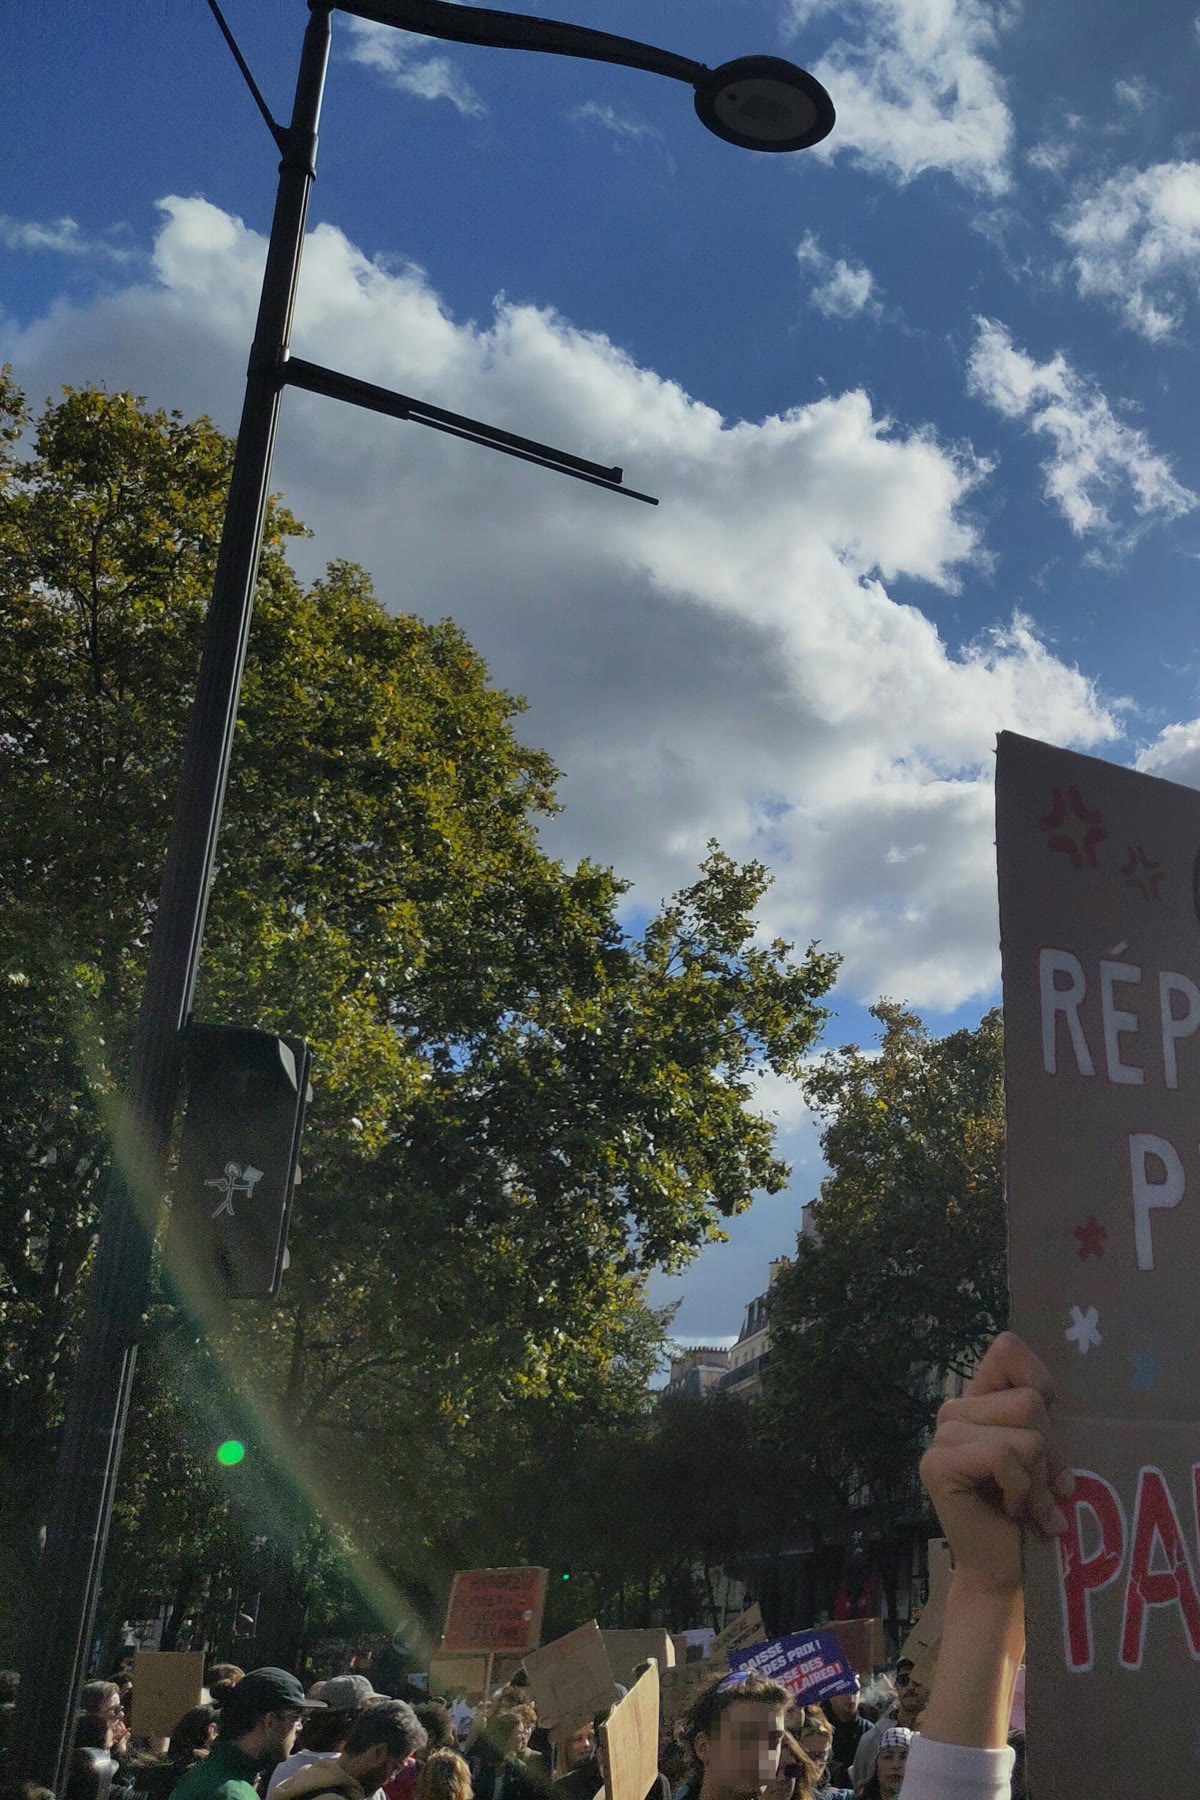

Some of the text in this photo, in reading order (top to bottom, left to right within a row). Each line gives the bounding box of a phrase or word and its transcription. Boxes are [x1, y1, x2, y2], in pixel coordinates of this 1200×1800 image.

[761, 1655, 787, 1676] DES
[787, 1641, 816, 1662] PRIX
[800, 1656, 824, 1675] DES
